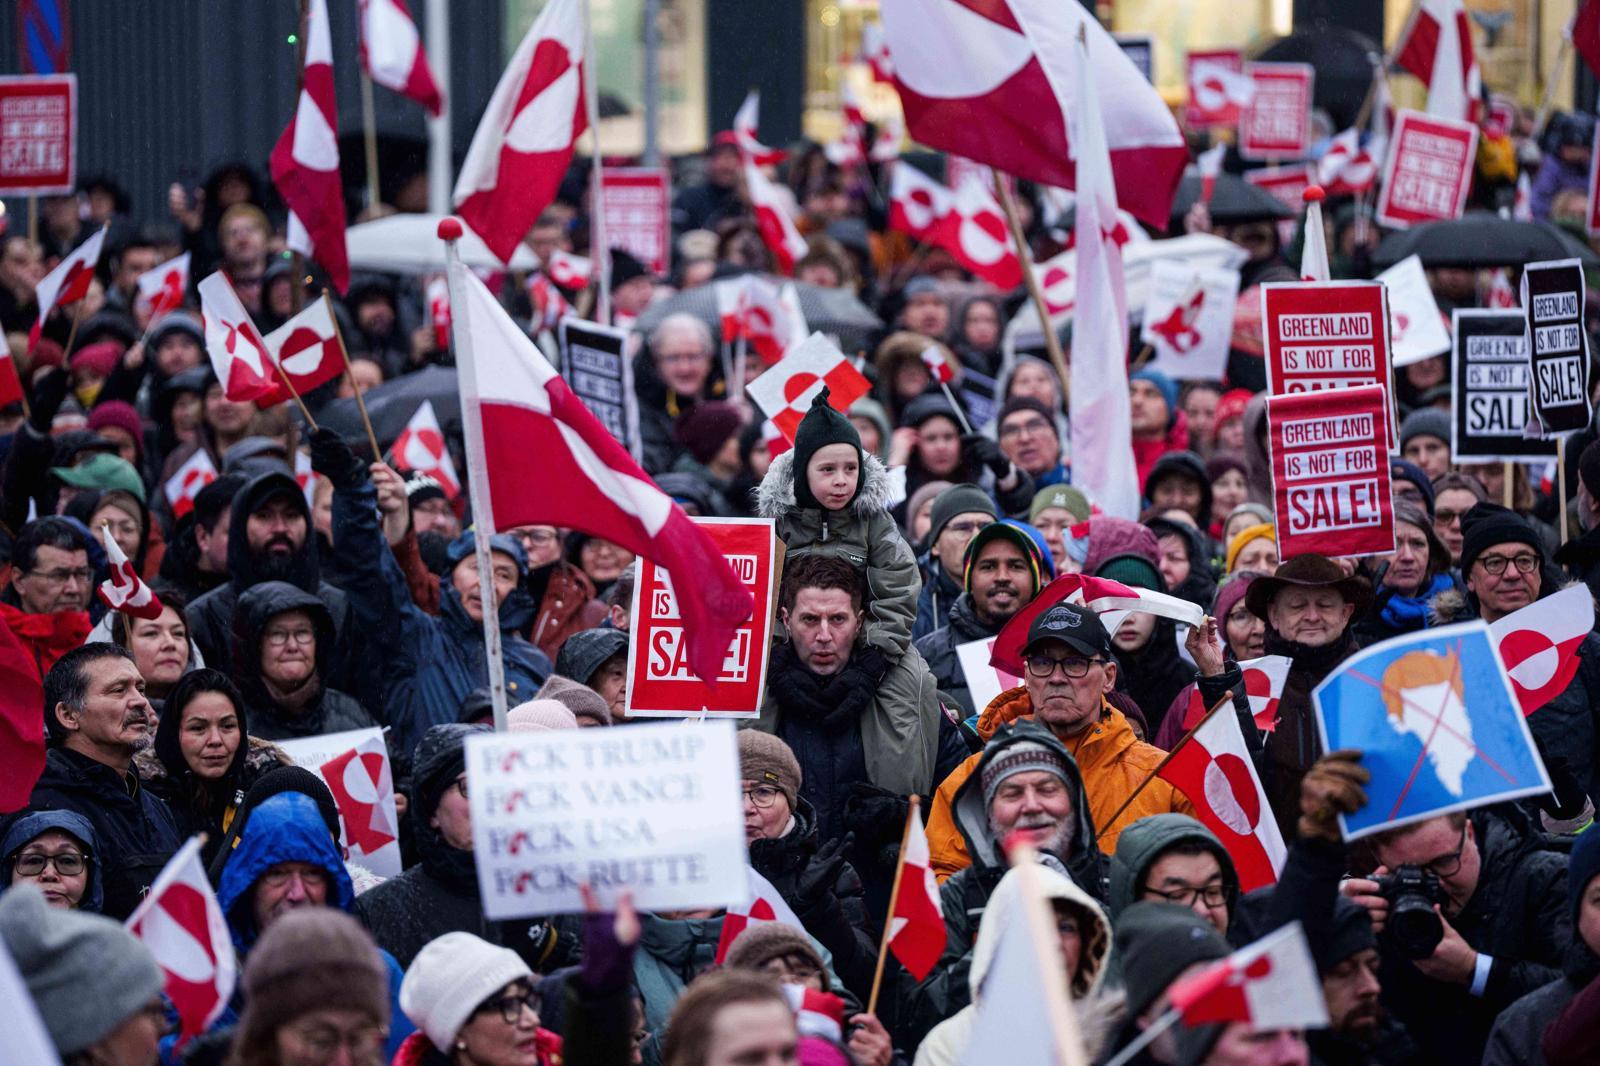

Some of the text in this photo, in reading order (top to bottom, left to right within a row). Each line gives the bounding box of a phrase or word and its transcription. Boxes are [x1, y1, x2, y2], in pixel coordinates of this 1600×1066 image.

[1535, 294, 1577, 318] GREENLAND
[1282, 316, 1369, 337] GREENLAND
[1536, 328, 1578, 350] IS NOT FOR
[1285, 348, 1372, 369] IS NOT FOR
[1470, 367, 1482, 384] IS
[1488, 367, 1513, 384] NOT
[1539, 360, 1582, 404] SALE!
[1285, 416, 1372, 444] GREENLAND
[1287, 449, 1374, 477] IS NOT FOR
[1290, 482, 1379, 531] SALE!
[655, 593, 670, 615] IS
[582, 734, 705, 771] TRUMP
[580, 773, 703, 810] VANCE
[584, 817, 657, 851] USA
[587, 853, 711, 888] RUTTE
